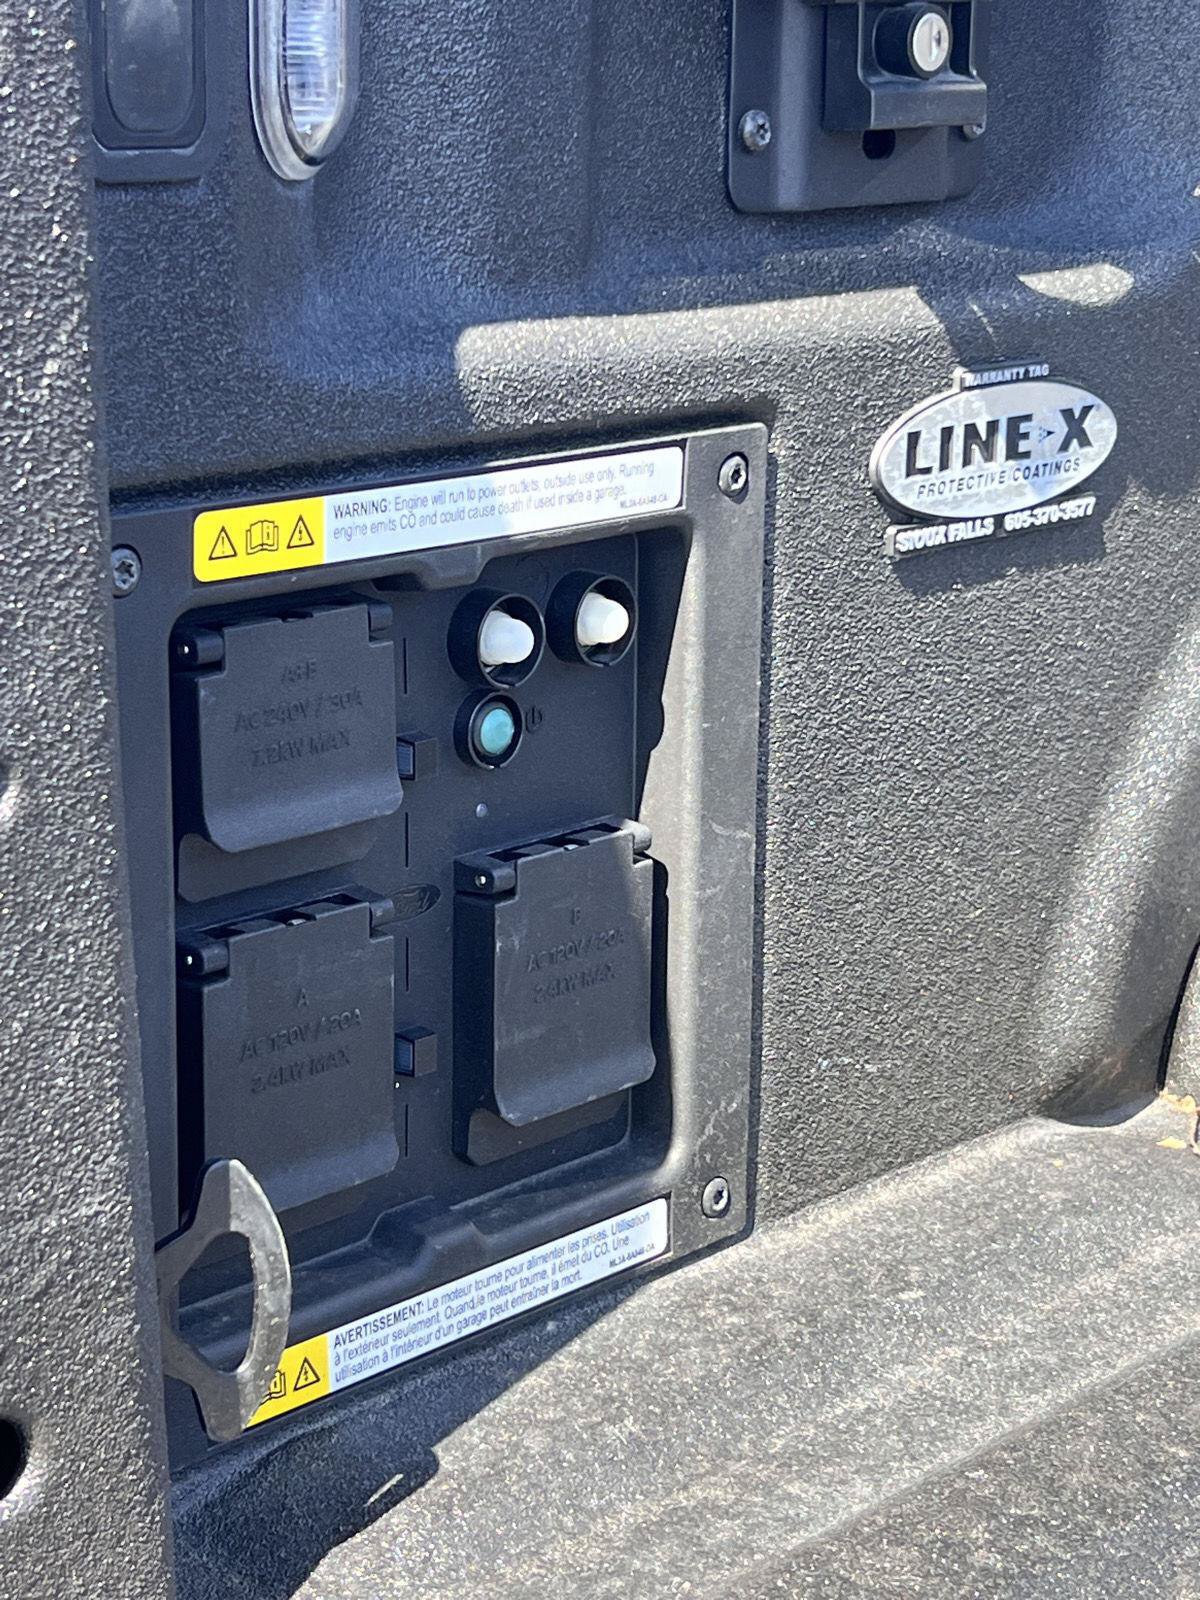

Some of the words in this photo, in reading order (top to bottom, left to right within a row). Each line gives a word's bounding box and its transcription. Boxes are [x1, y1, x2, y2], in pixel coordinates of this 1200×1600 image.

[962, 366, 1025, 388] WARRANTY
[1028, 363, 1050, 379] TAG
[333, 498, 391, 520] WARNING:
[394, 495, 429, 513] Engine
[431, 489, 447, 506] will
[449, 489, 465, 504] run
[466, 488, 477, 501] to
[478, 484, 507, 504] power
[544, 471, 577, 490] outside
[579, 471, 595, 485] use
[620, 460, 656, 478] Running
[916, 470, 1007, 500] PROTECTIVE
[1012, 456, 1082, 482] COATINGS
[333, 520, 369, 541] engine
[370, 516, 397, 534] emits
[399, 513, 417, 530] CO
[419, 511, 438, 528] and
[439, 506, 466, 525] could
[467, 503, 497, 521] cause
[498, 498, 523, 516] death
[534, 492, 557, 510] used
[558, 487, 585, 506] inside
[586, 489, 593, 502] a
[895, 523, 948, 552] SIOUX
[949, 517, 995, 542] FALLS
[333, 1300, 425, 1349] AVERTISSEMENT:
[427, 1297, 439, 1311] Le
[441, 1283, 472, 1306] moteur
[474, 1271, 503, 1292] tourne
[504, 1262, 525, 1283] pour
[526, 1245, 565, 1271] alimenter
[567, 1239, 580, 1254] les
[611, 1211, 650, 1236] Utilisation
[443, 1296, 475, 1321] Quand
[476, 1294, 486, 1308] le
[487, 1280, 518, 1302] moteur
[551, 1261, 557, 1277] il
[581, 1249, 592, 1265] du
[612, 1234, 630, 1252] Une
[334, 1354, 381, 1383] utilisation
[455, 1308, 487, 1336] garage
[489, 1297, 510, 1321] peut
[551, 1277, 560, 1292] la
